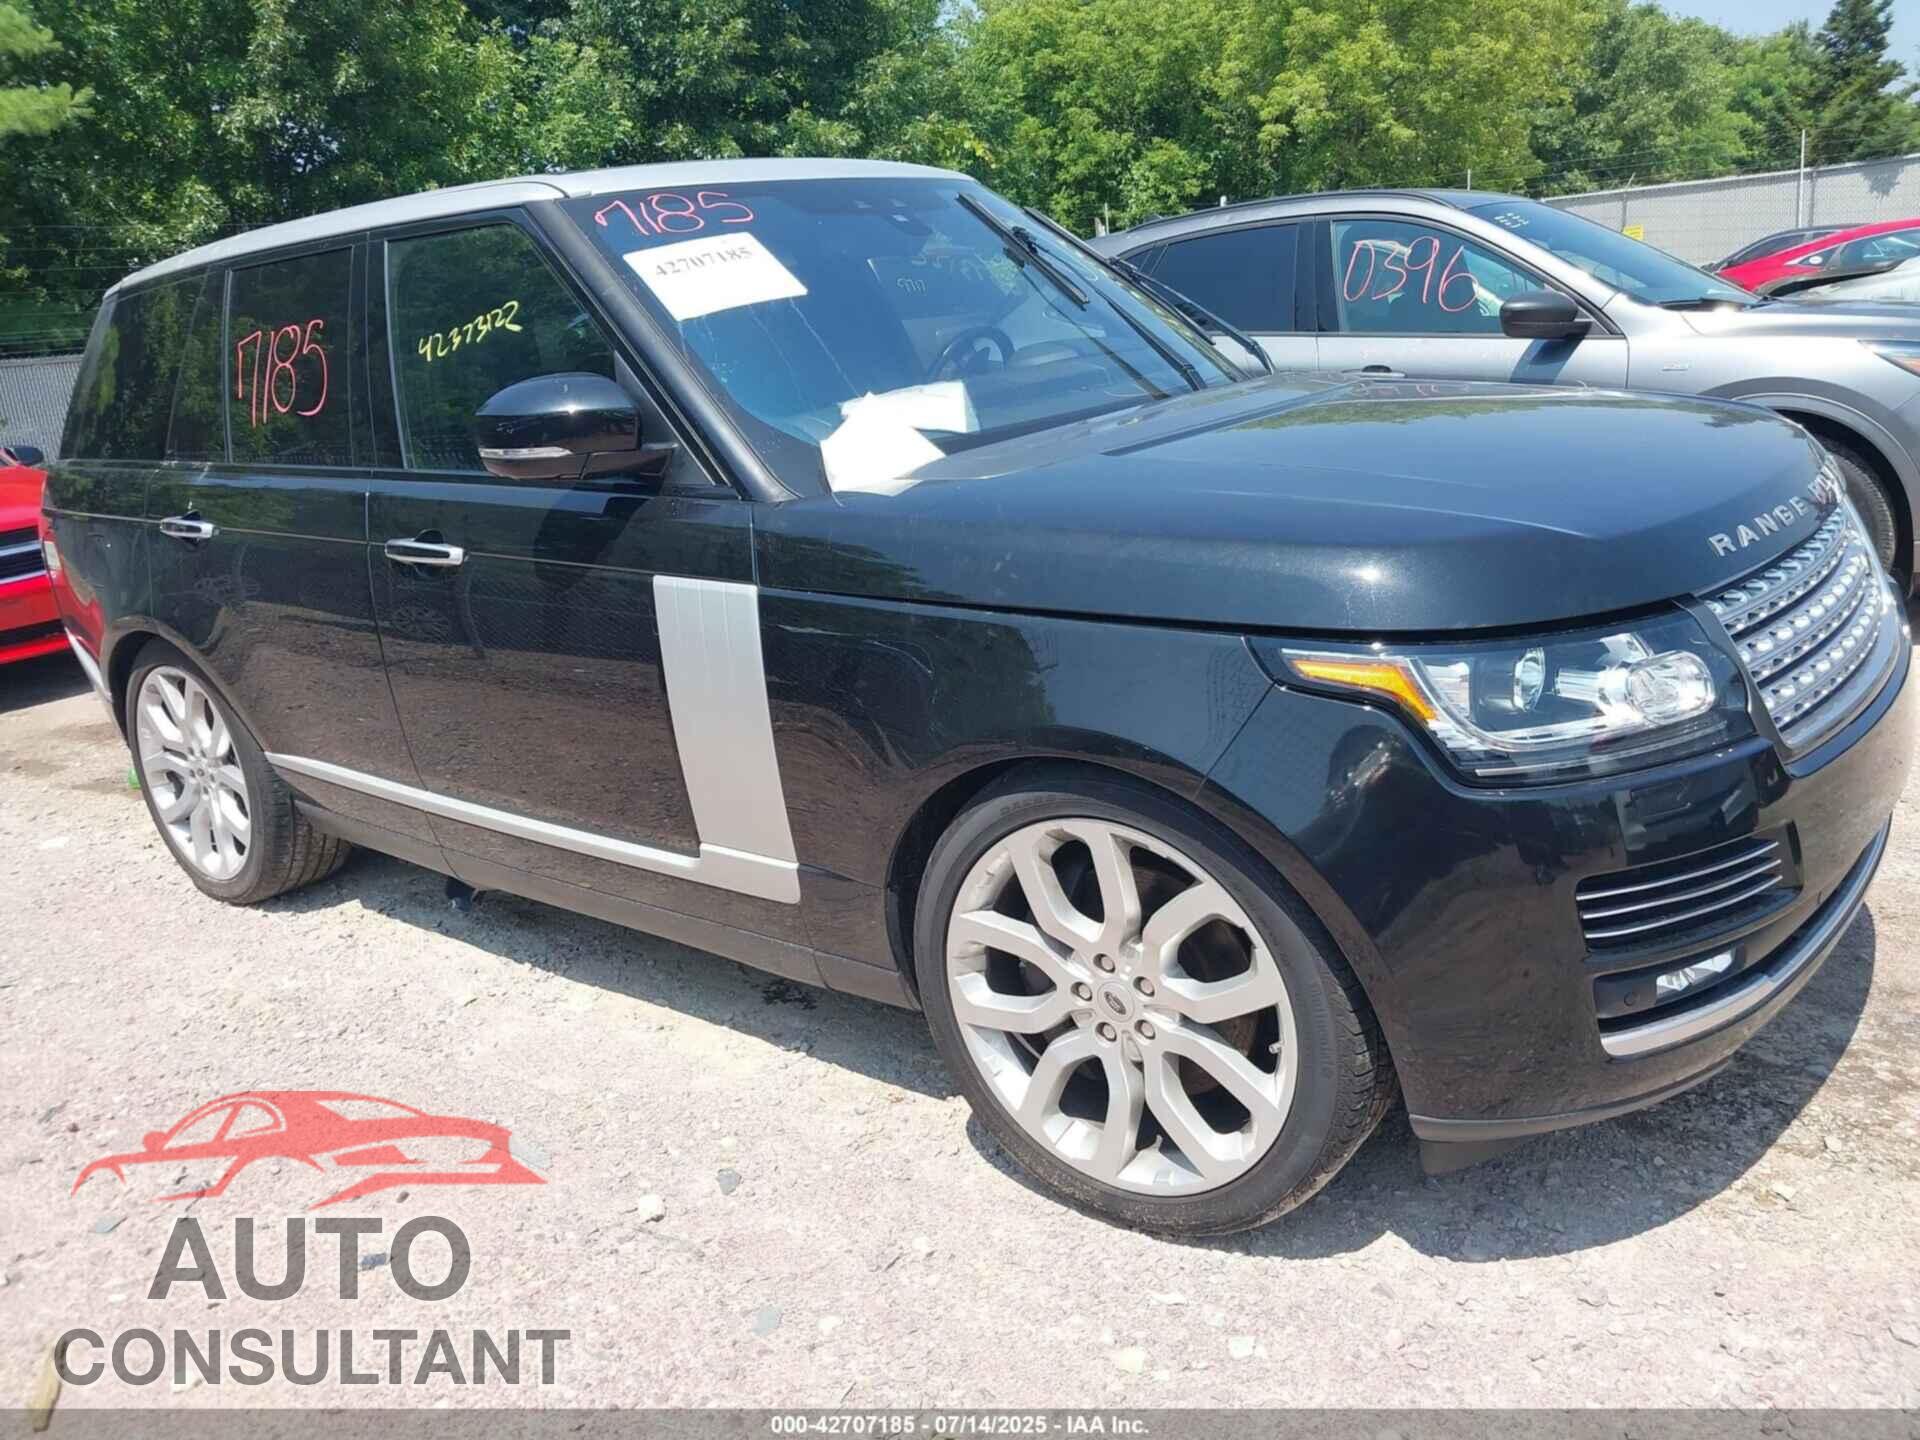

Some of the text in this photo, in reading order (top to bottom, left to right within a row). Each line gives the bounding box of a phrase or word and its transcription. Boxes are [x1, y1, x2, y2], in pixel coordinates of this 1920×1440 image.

[594, 191, 755, 236] 7185
[656, 246, 753, 276] 42707185
[1343, 236, 1480, 312] 0396
[236, 318, 329, 428] 7185
[1708, 495, 1809, 558] RANGE
